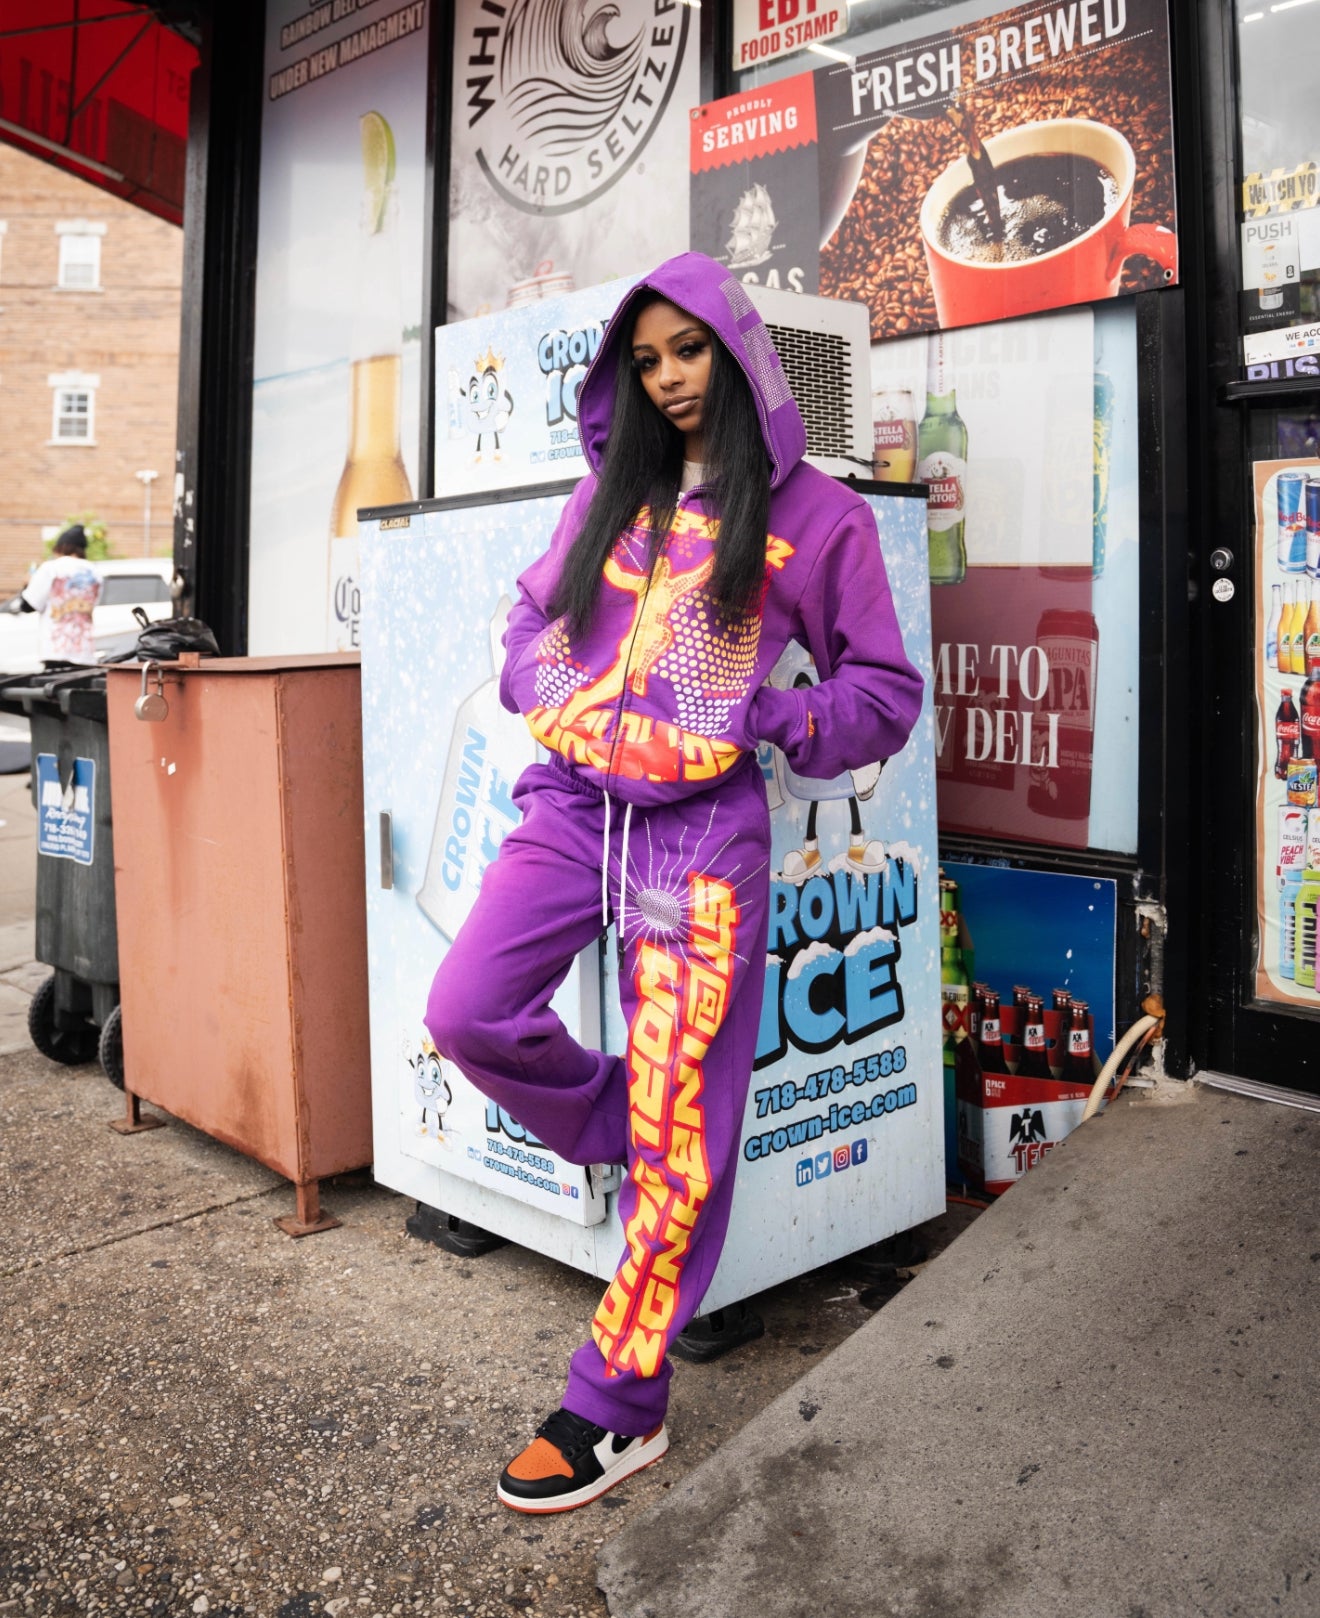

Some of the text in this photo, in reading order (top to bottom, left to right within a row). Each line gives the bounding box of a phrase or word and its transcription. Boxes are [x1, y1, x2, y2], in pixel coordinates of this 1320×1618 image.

[281, 1, 333, 50] RAINBOW
[741, 10, 839, 64] FOOD STAMP
[270, 2, 425, 100] UNDER NEW MANAGMENT
[851, 0, 1127, 116] FRESH BREWED
[498, 0, 676, 196] HARD SELTZER
[726, 98, 773, 120] PROUDLY
[702, 106, 798, 153] SERVING
[1249, 176, 1296, 205] WATCH
[1246, 220, 1292, 243] PUSH
[1249, 312, 1275, 320] ESSENTIAL
[1285, 331, 1301, 341] WE
[990, 644, 1050, 701] TO
[965, 707, 1060, 769] DELI
[441, 726, 488, 892] CROWN
[1280, 854, 1296, 865] VIBE
[1281, 843, 1305, 856] PEACH
[1282, 834, 1304, 842] CELSIUS
[755, 1046, 906, 1118] 718-478-5588
[991, 1080, 1006, 1089] PACK
[744, 1083, 917, 1161] crown-ice.com
[483, 1156, 560, 1195] crown-ice.com
[487, 1138, 555, 1175] 718-478-5588
